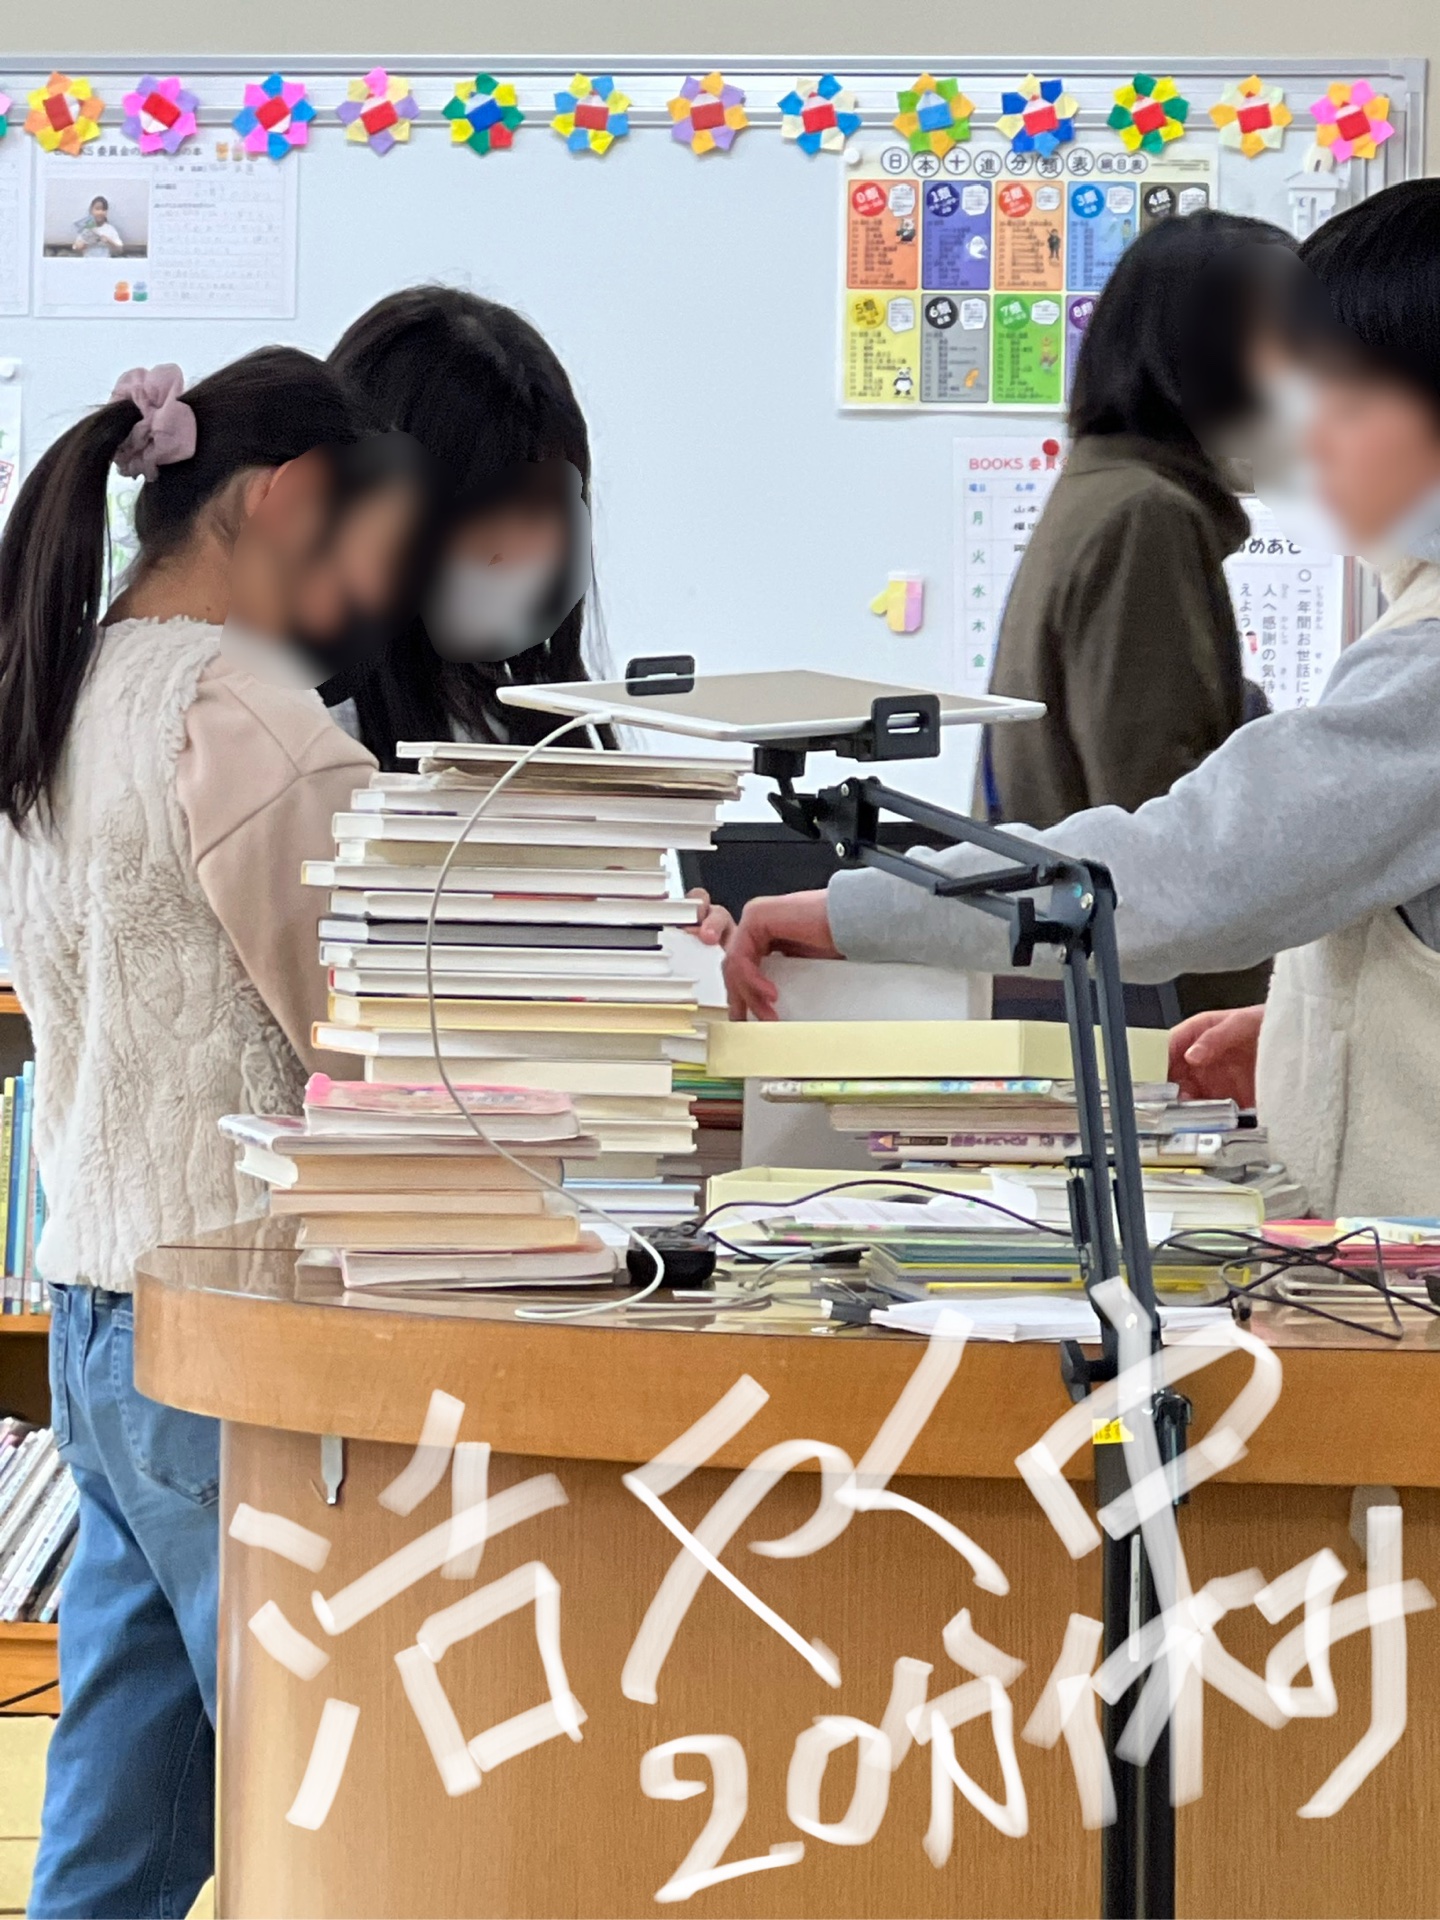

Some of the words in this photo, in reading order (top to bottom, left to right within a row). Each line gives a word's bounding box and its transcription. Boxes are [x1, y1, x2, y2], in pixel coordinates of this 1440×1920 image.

[886, 150, 1091, 177] 日本十進分類表
[968, 457, 1024, 470] BOOKS
[972, 511, 984, 526] 月
[972, 550, 986, 565] 火
[972, 584, 986, 598] 水
[972, 618, 986, 633] 木
[1261, 583, 1278, 711] 人へ感謝の気持
[972, 654, 986, 668] 金
